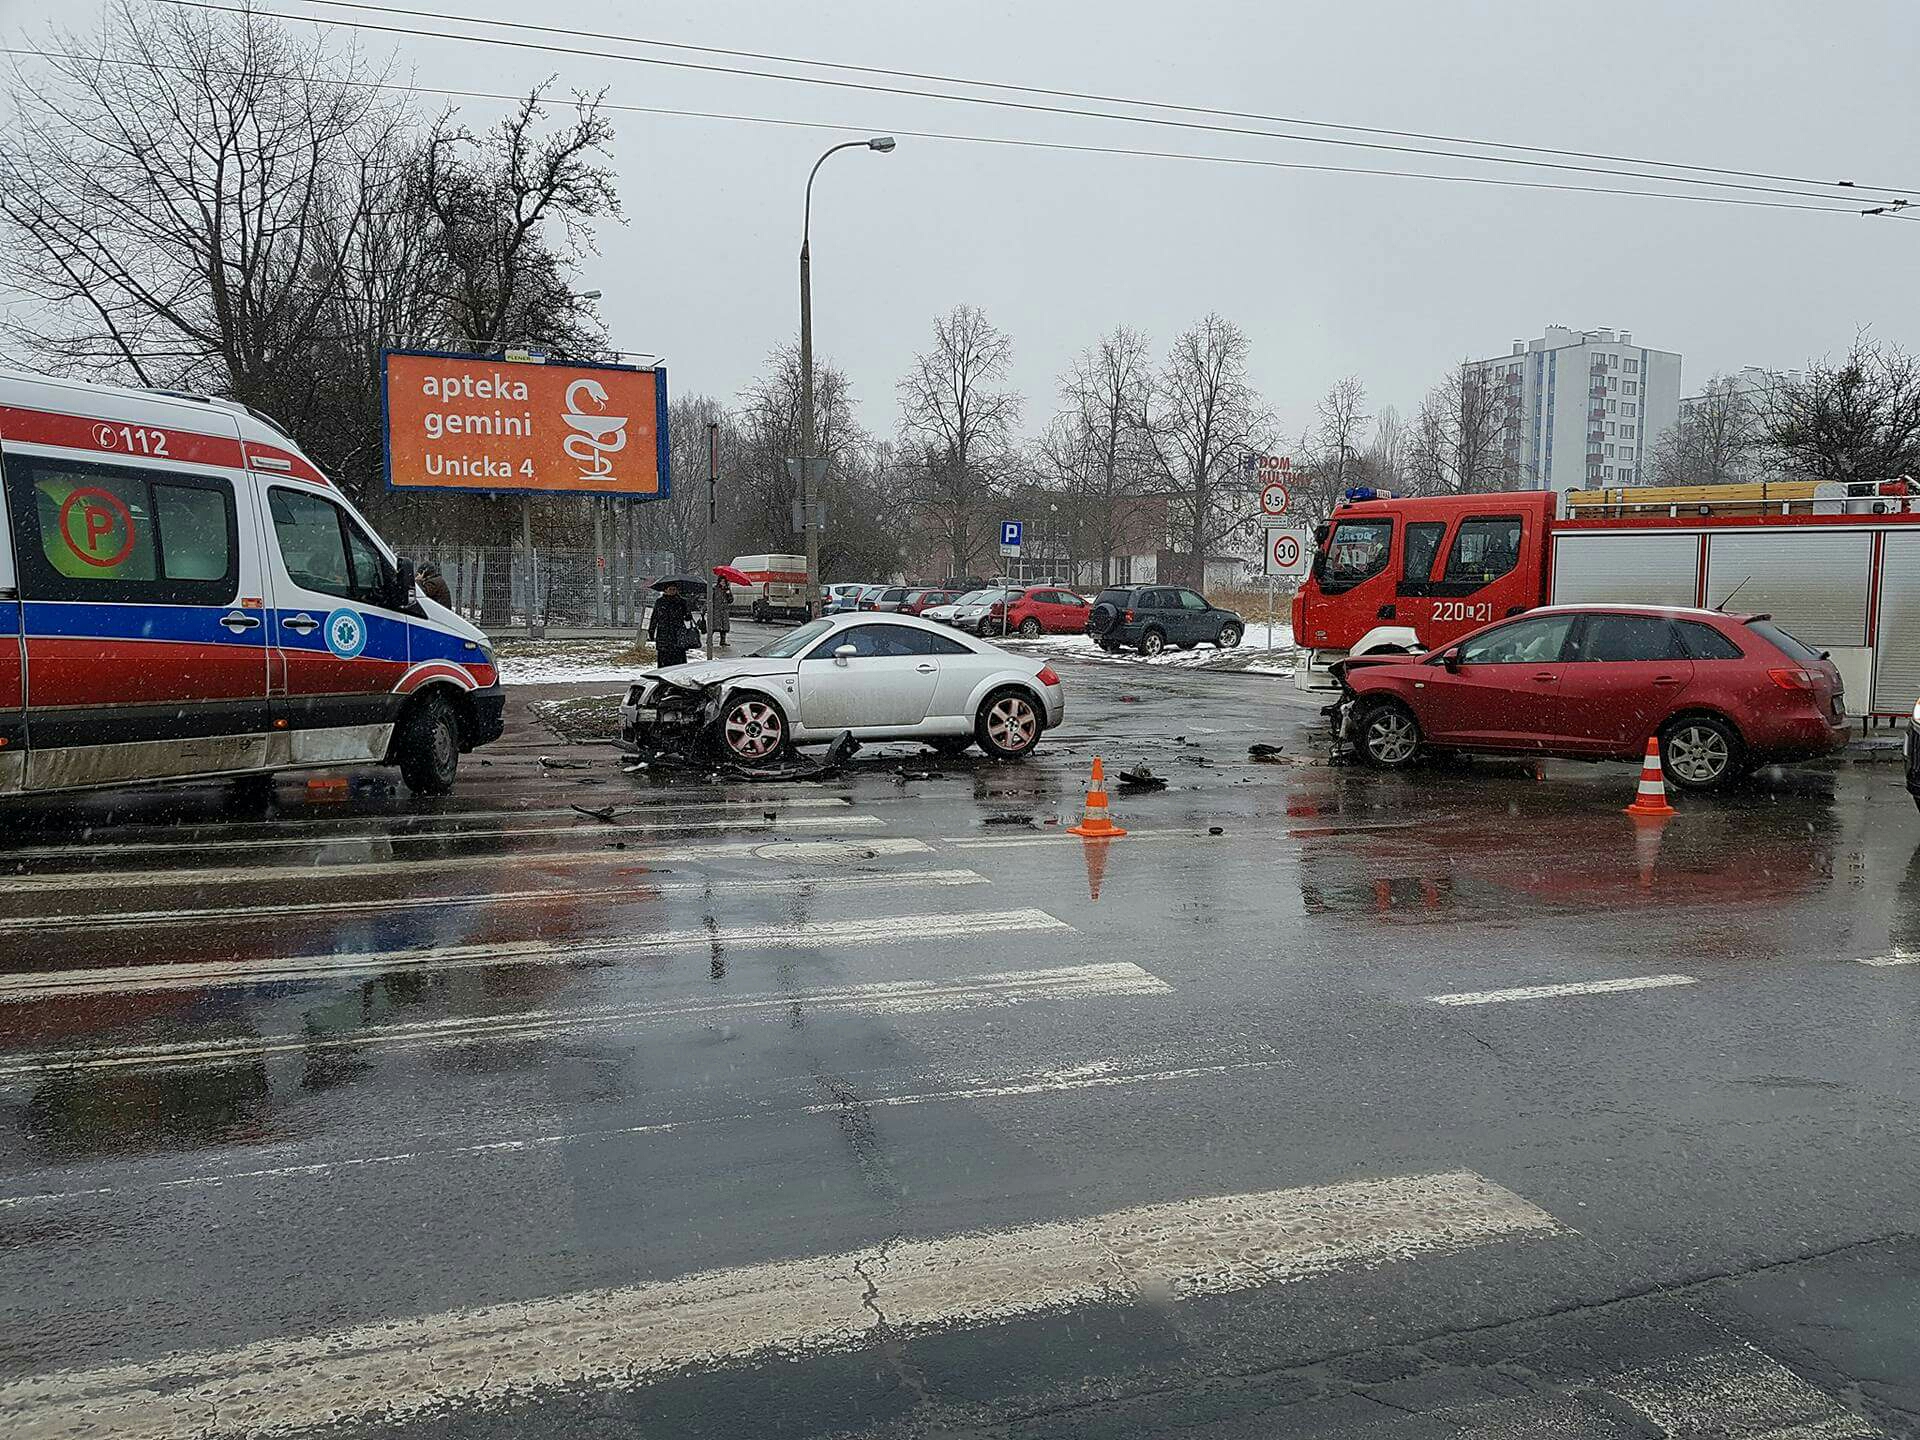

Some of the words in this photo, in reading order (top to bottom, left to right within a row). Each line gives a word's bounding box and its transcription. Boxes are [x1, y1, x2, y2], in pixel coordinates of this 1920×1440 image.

[422, 374, 529, 403] apteka
[424, 411, 532, 440] gemini
[119, 426, 169, 456] 112
[425, 454, 512, 478] Unicka
[518, 458, 535, 478] 4
[1259, 455, 1290, 470] DOM
[83, 505, 113, 550] P
[1005, 524, 1017, 542] P
[1277, 544, 1296, 559] 30
